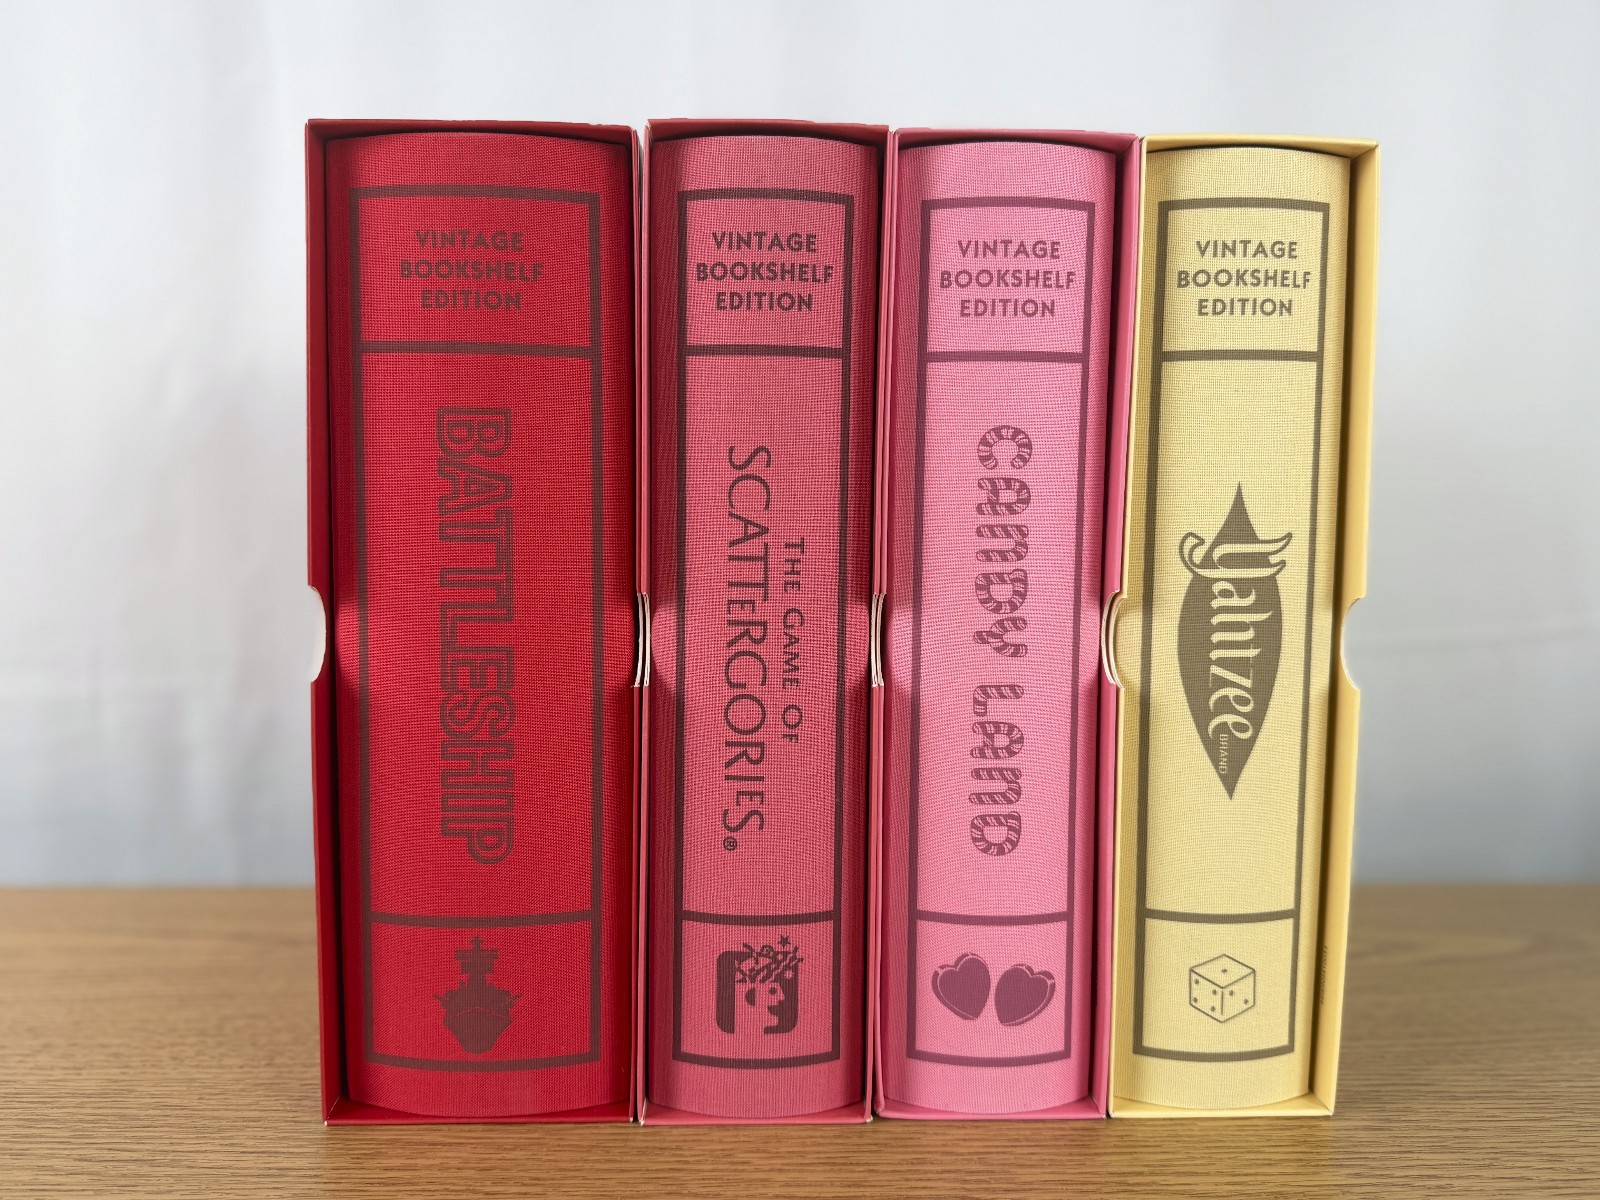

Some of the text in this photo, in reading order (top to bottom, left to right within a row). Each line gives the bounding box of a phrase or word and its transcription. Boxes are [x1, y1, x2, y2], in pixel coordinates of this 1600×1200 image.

[416, 229, 524, 252] VINTAGE
[712, 231, 817, 253] VINTAGE
[958, 239, 1060, 259] VINTAGE
[1196, 239, 1298, 259] VINTAGE
[400, 259, 544, 282] BOOKSHELF
[696, 261, 834, 284] BOOKSHELF
[940, 269, 1075, 289] BOOKSHELF
[1177, 268, 1311, 289] BOOKSHELF
[420, 289, 522, 310] EDITION
[716, 291, 813, 311] EDITION
[960, 298, 1055, 317] EDITION
[1197, 298, 1293, 316] EDITION
[437, 407, 515, 865] BATTLESHIP
[781, 537, 804, 743] THE GAME OF
[1179, 531, 1293, 740] Yahtzee
[1217, 734, 1229, 774] BRAND
